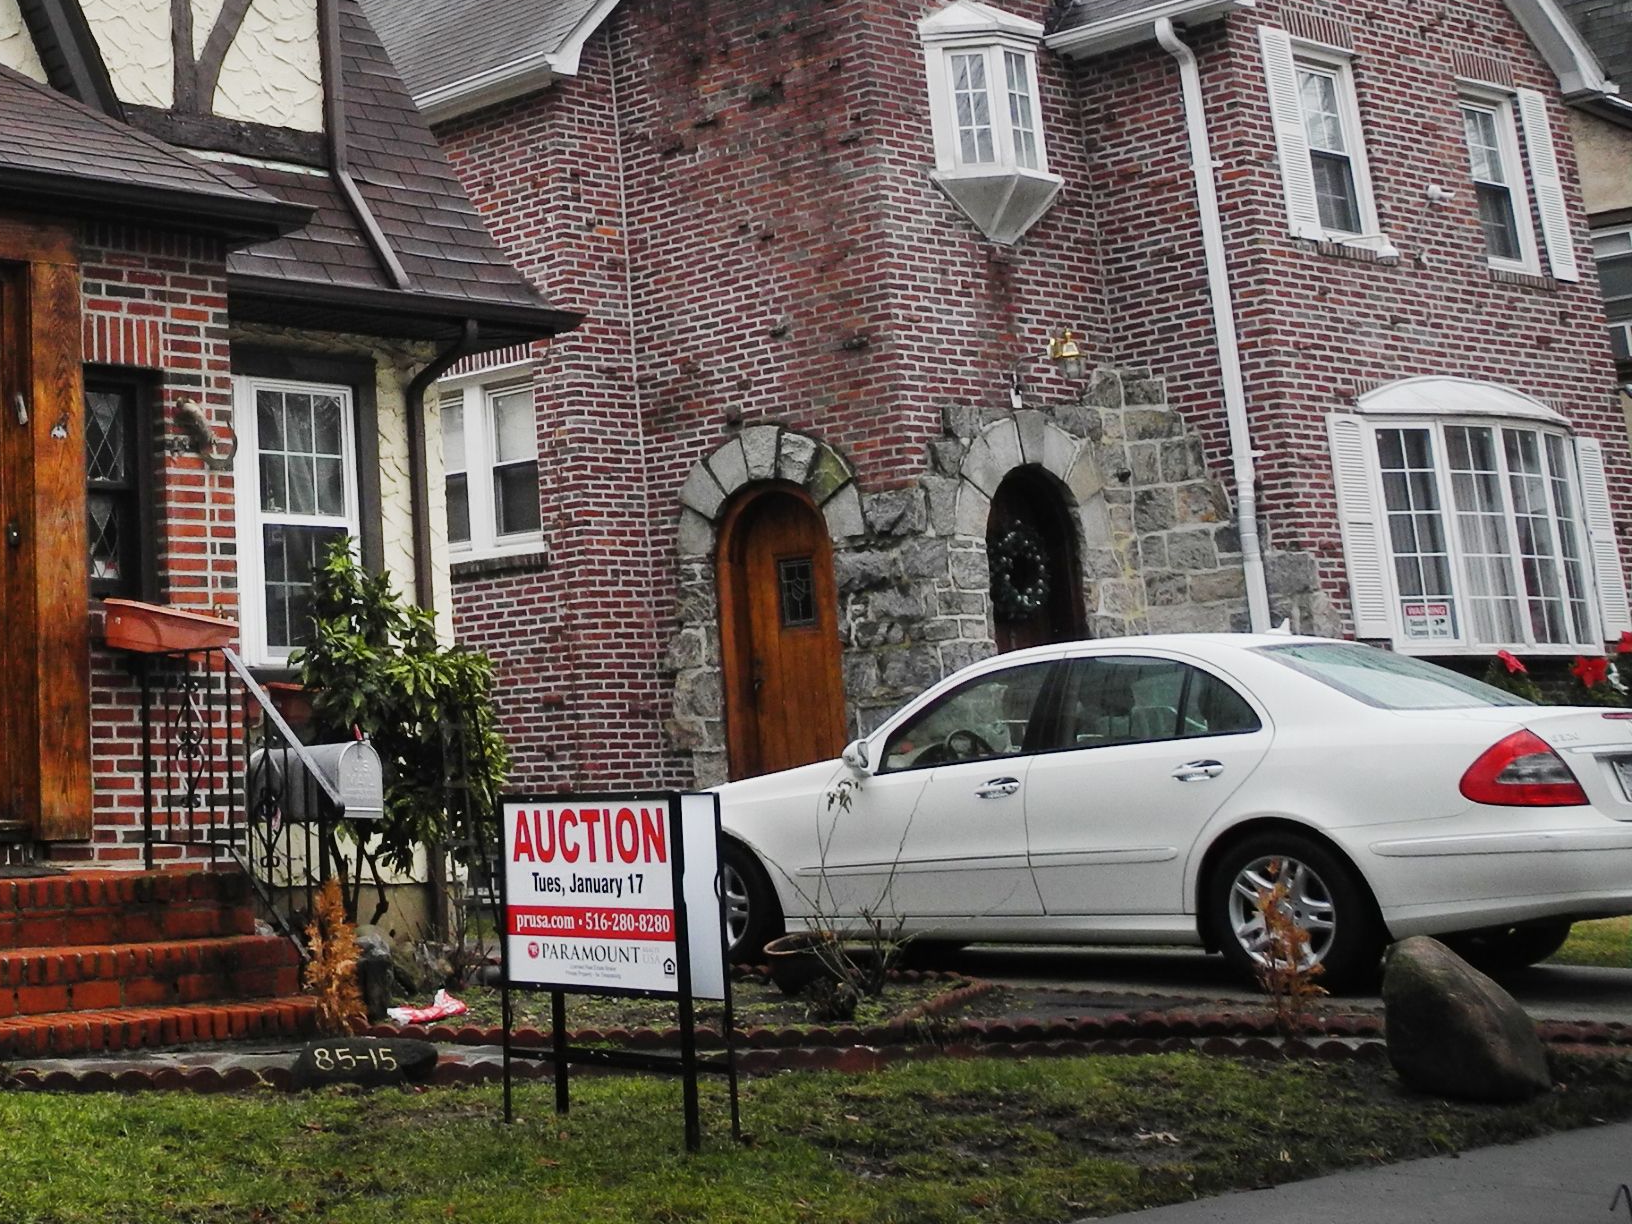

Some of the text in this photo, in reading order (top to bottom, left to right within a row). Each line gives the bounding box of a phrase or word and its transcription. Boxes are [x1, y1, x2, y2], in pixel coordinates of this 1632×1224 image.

[513, 807, 667, 864] AUCTION
[532, 872, 644, 898] Tues, January 17
[516, 912, 670, 933] prusa.com 516-280-8280
[542, 942, 641, 964] PARAMOUNT
[314, 1047, 398, 1072] 85-15
